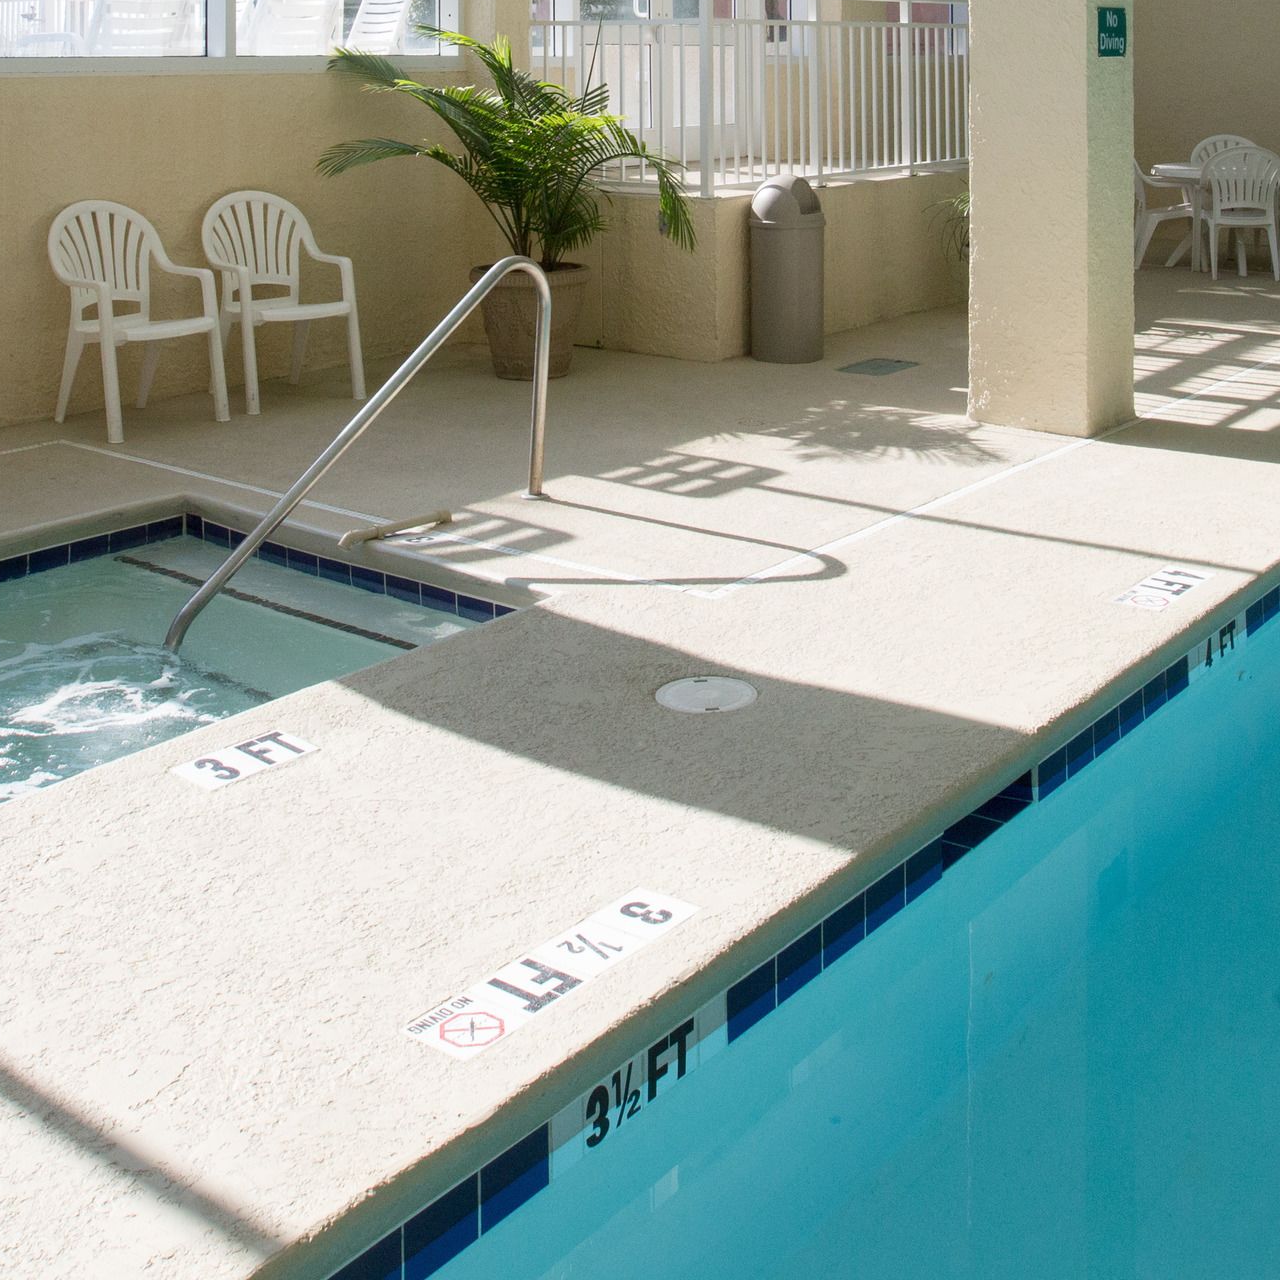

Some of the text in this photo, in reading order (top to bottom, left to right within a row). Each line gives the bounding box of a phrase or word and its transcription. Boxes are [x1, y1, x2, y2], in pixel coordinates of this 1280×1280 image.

[1106, 10, 1118, 27] No
[1100, 33, 1124, 53] Diving
[1219, 619, 1236, 658] FT
[194, 731, 306, 780] 3 FT
[619, 901, 673, 925] 3
[486, 957, 585, 1014] FT
[407, 995, 474, 1034] NO DIVING
[647, 1016, 695, 1104] FT
